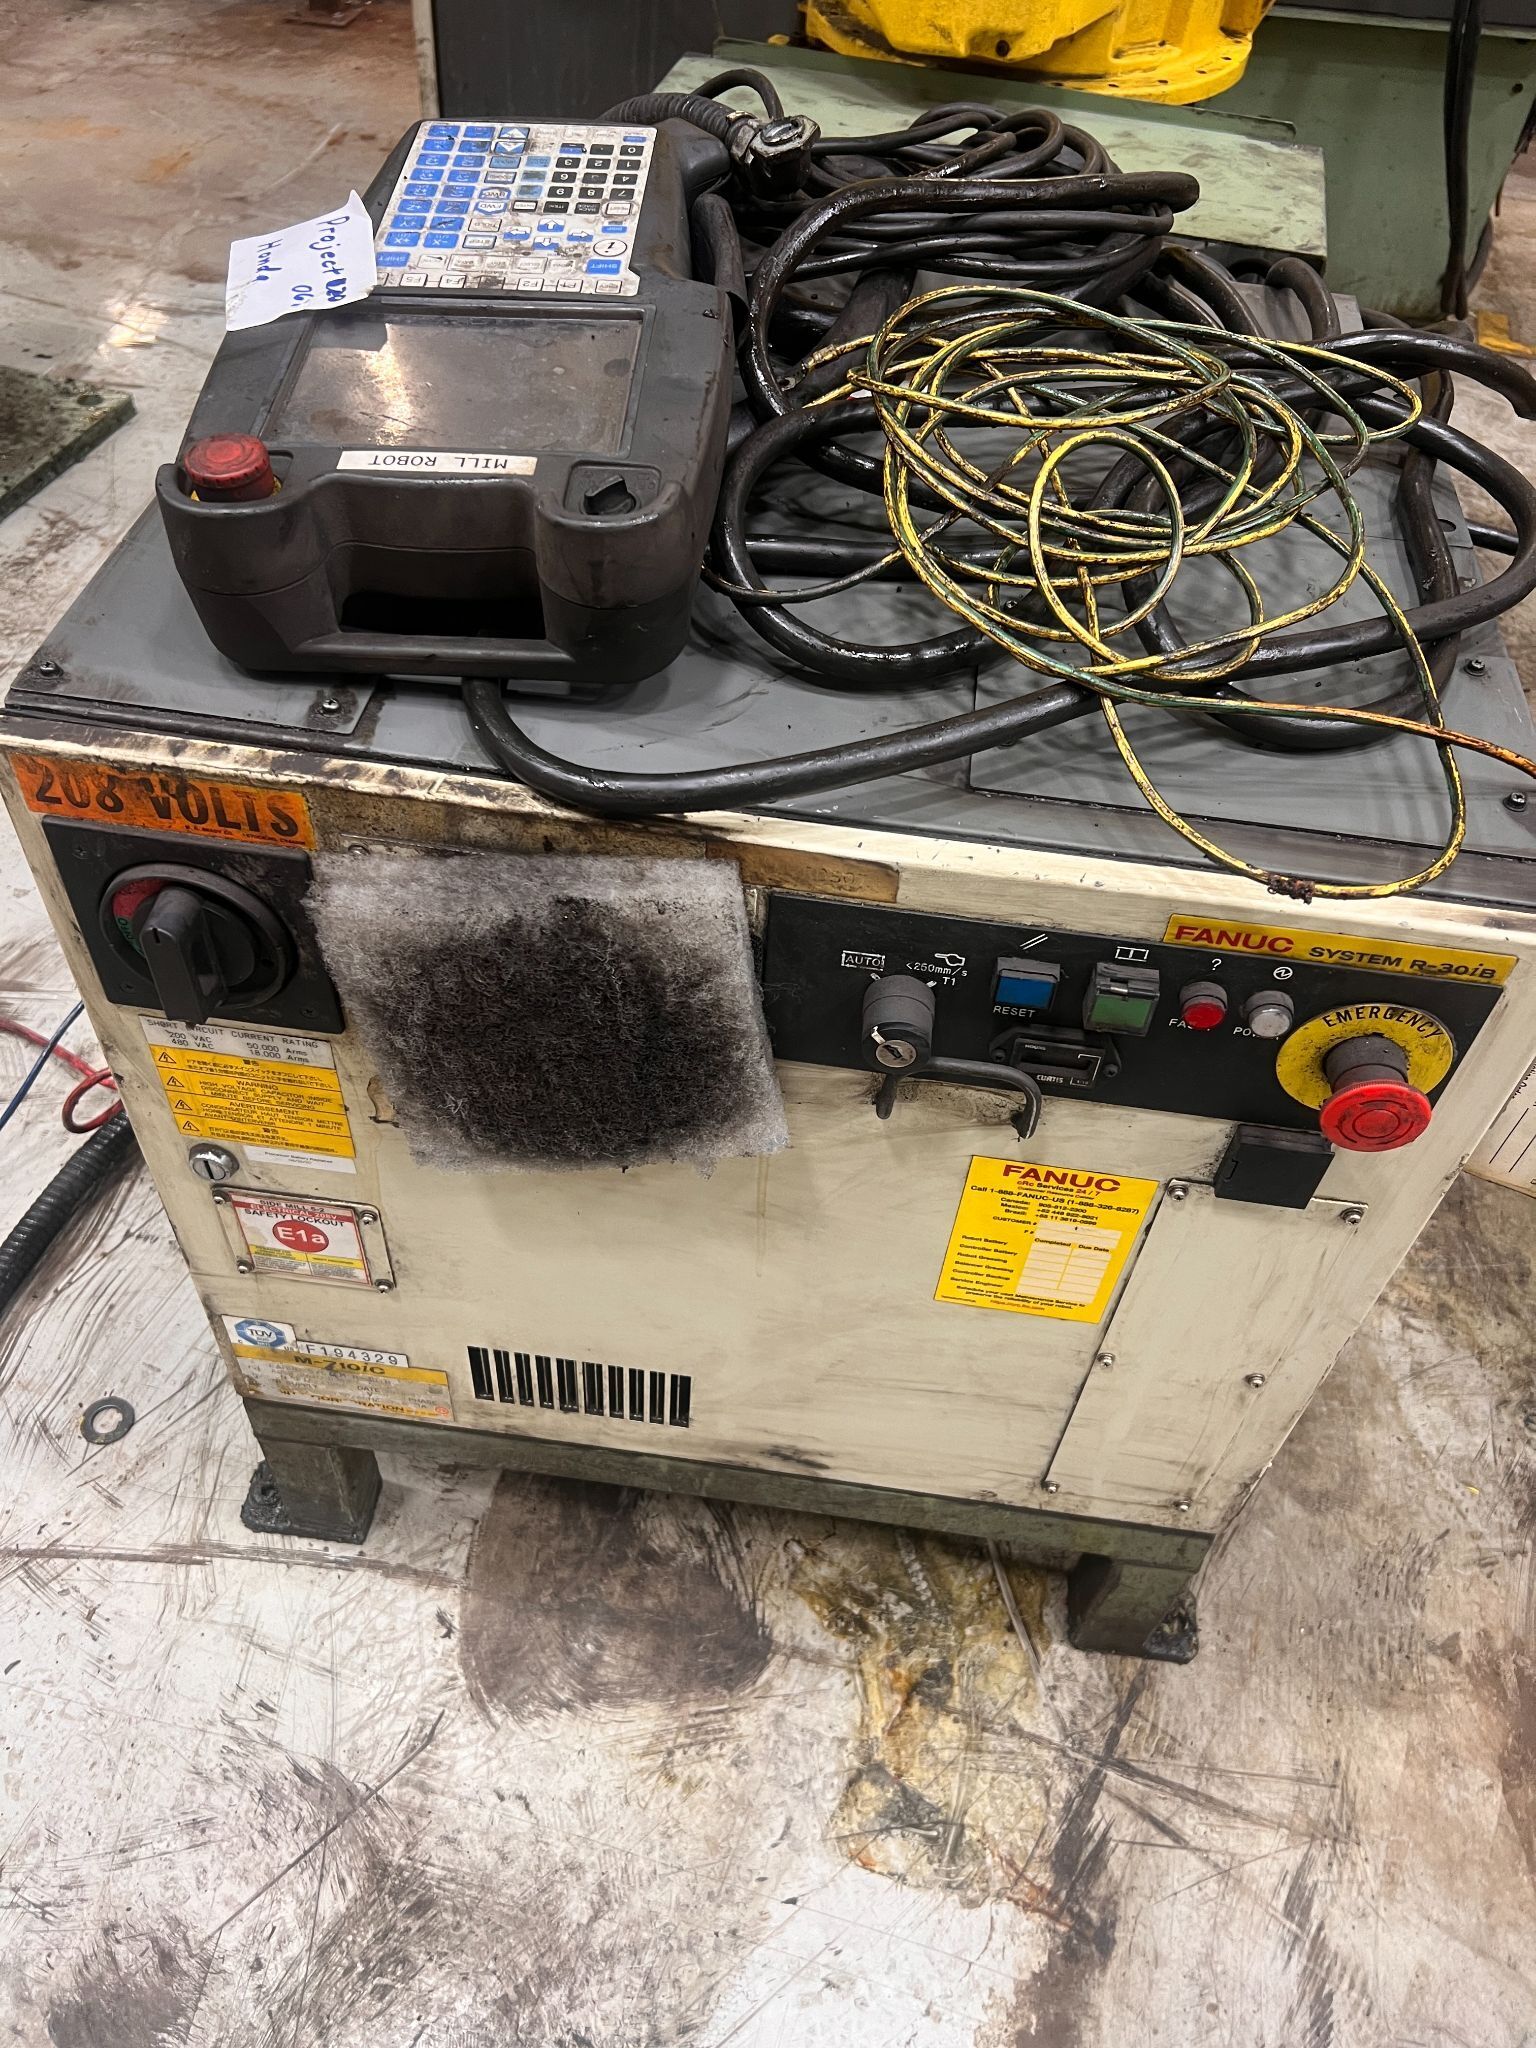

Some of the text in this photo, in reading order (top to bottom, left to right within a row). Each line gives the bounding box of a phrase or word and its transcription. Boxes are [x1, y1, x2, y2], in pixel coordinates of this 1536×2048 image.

[309, 216, 350, 274] Project
[256, 239, 283, 281] Honda
[368, 455, 508, 469] MILL ROBOT
[28, 763, 299, 838] 208 VOLTS
[846, 956, 880, 967] AUTO
[1174, 925, 1496, 979] FANUC SYSTEM R-30iB
[942, 976, 956, 986] T1
[993, 1005, 1036, 1018] RESET
[1322, 1006, 1444, 1040] EMERGENCY
[146, 1019, 178, 1030] SHORT
[230, 1030, 275, 1042] CURRENT
[281, 1037, 318, 1048] RATING
[168, 1031, 186, 1039] 200
[192, 1034, 212, 1043] VAC
[284, 1047, 308, 1056] Arms
[170, 1038, 189, 1046] 480
[194, 1041, 214, 1049] VAC
[286, 1054, 309, 1062] Arms
[235, 1079, 278, 1090] WARNING
[1036, 1074, 1064, 1084] CURTIS
[228, 1101, 299, 1115] AVERTISSEMENT
[1002, 1164, 1122, 1193] FANUC
[1036, 1182, 1074, 1192] Services
[990, 1188, 1065, 1203] 1-888-FANUC-US
[244, 1208, 345, 1227] SAFETY LOCKOUT
[249, 1203, 312, 1216] ELECTRICAL
[992, 1216, 1031, 1224] CUSTOMER
[276, 1225, 326, 1244] E1a
[1033, 1238, 1071, 1247] Completed
[305, 1343, 398, 1365] F194329
[293, 1354, 385, 1376] M-710iC
